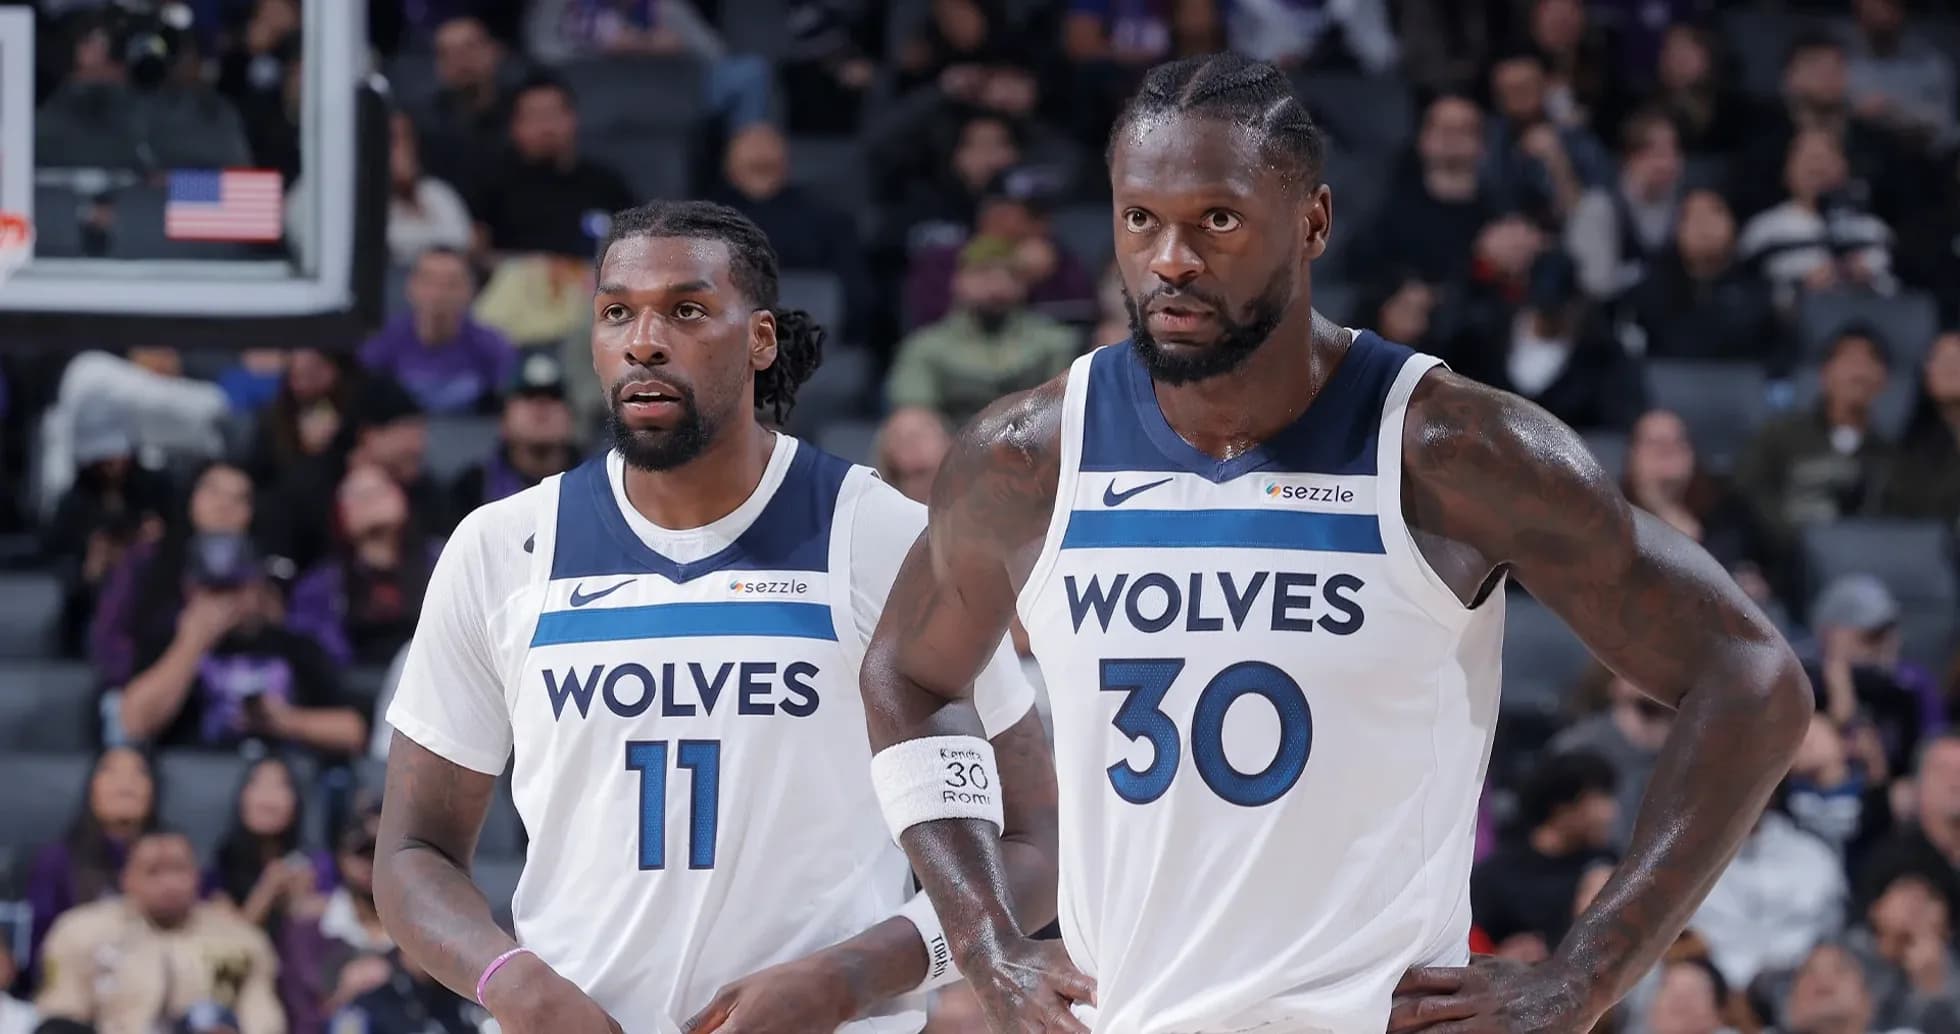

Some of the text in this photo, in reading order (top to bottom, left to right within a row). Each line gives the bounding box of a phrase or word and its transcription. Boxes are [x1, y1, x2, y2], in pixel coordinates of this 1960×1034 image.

[1284, 485, 1354, 504] sezzle
[745, 578, 808, 595] sezzle
[1064, 571, 1366, 636] WOLVES
[542, 660, 821, 721] WOLVES
[1099, 658, 1313, 807] 30
[625, 739, 721, 871] 11
[945, 761, 988, 790] 30
